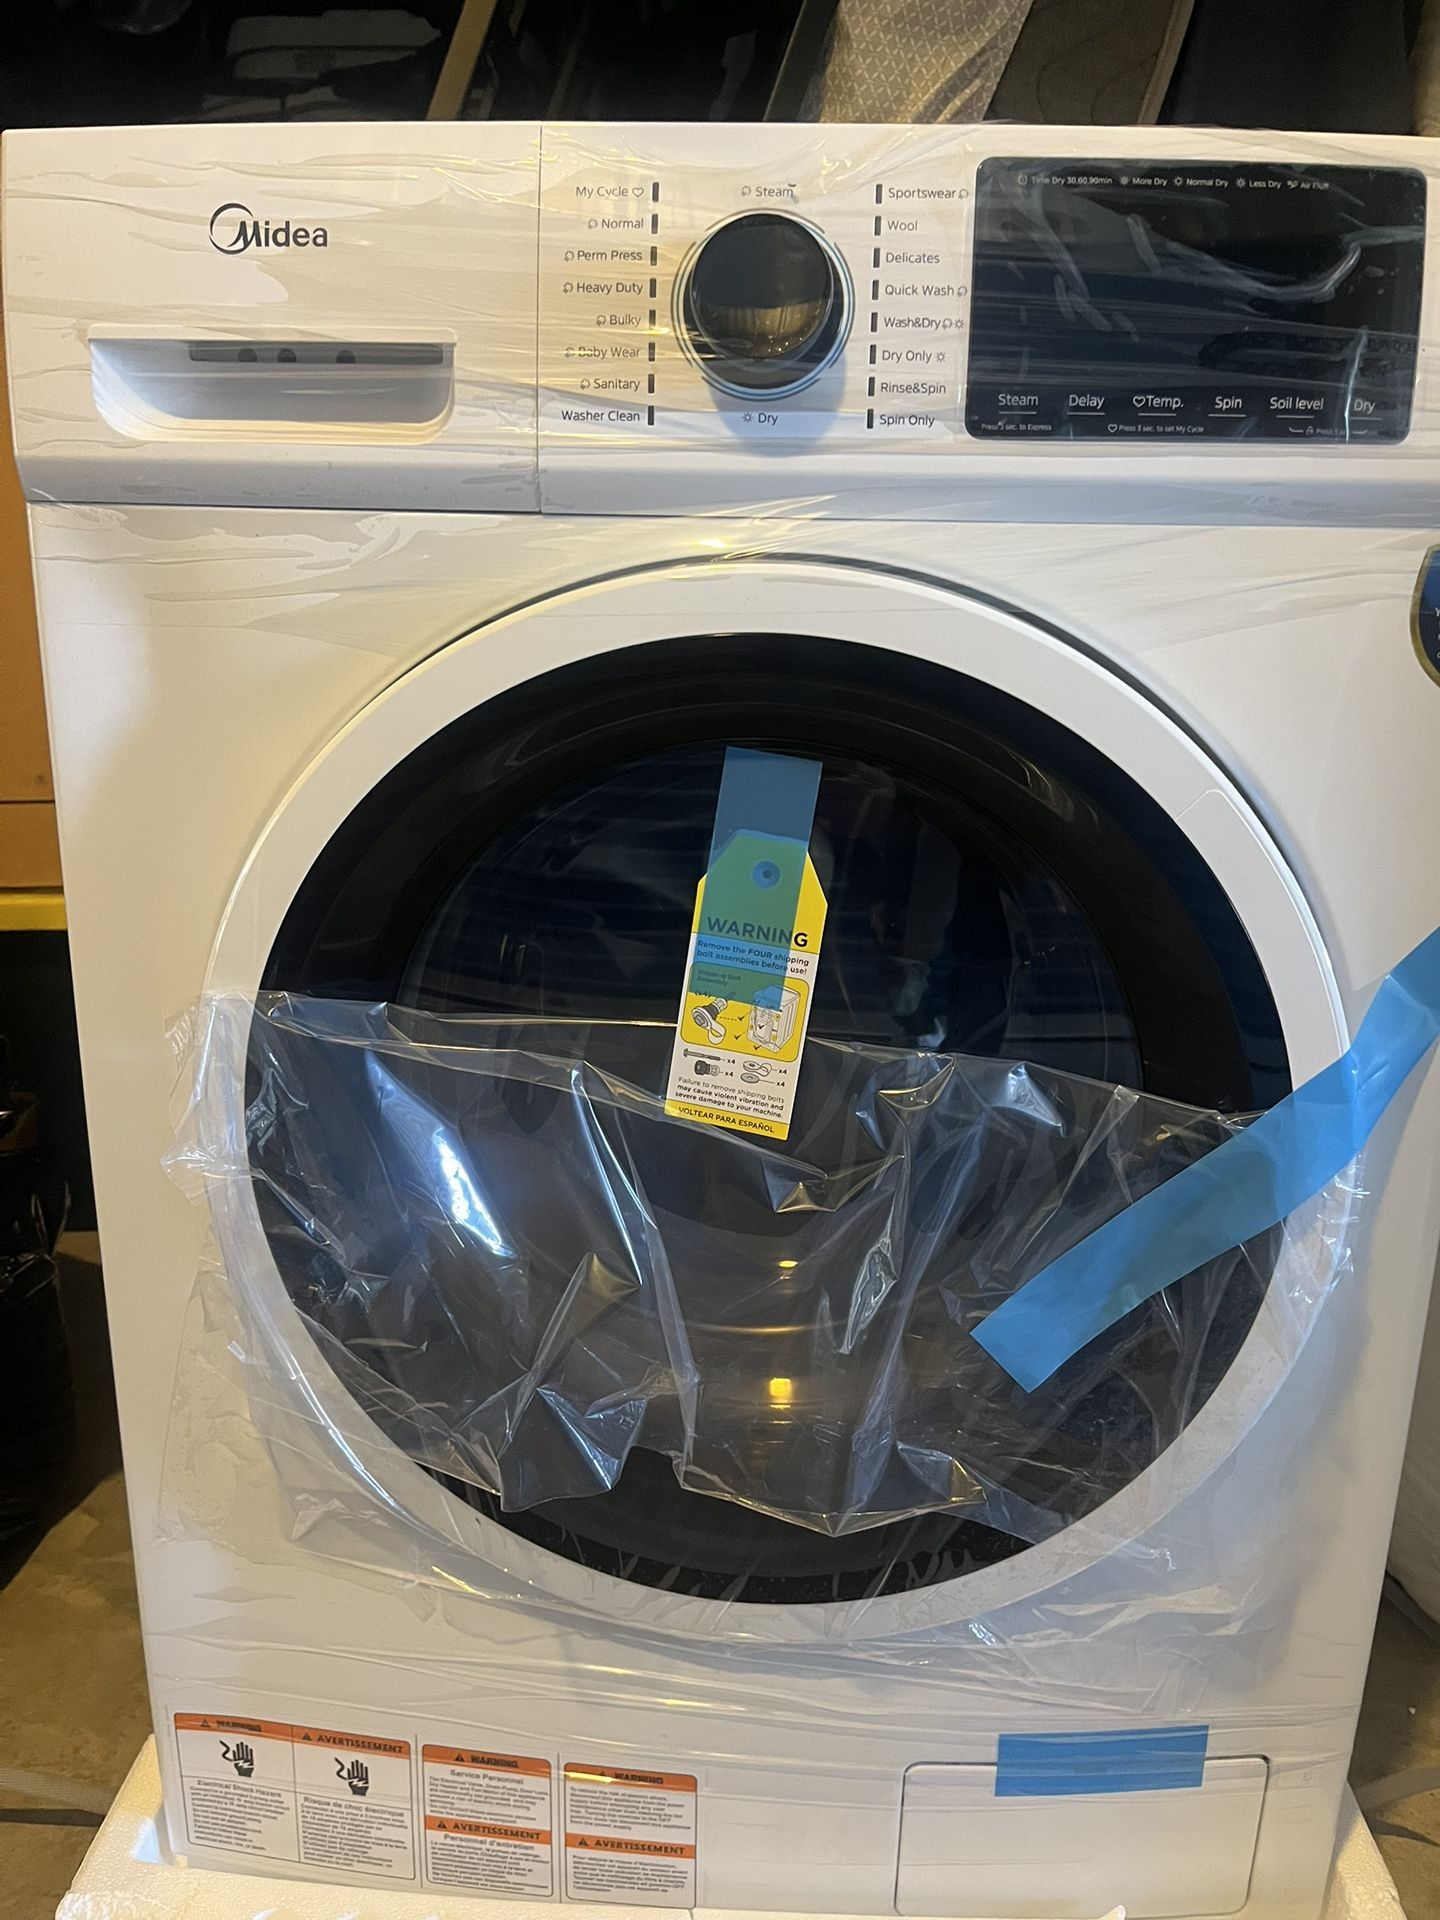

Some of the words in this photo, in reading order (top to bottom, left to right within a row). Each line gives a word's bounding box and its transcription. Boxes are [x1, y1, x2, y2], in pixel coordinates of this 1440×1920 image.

[1052, 177, 1065, 186] Dry
[1132, 177, 1152, 185] More
[1154, 178, 1167, 187] Dry
[1186, 178, 1214, 186] Normal
[1215, 179, 1228, 188] Dry
[1250, 179, 1266, 188] Less
[1268, 180, 1281, 189] Dry
[576, 186, 594, 199] My
[597, 186, 629, 198] Cycle
[754, 185, 794, 198] Steam
[888, 187, 956, 199] Sportswear
[208, 202, 328, 255] Midea
[601, 219, 644, 229] Normal
[887, 220, 918, 231] Wool
[577, 250, 607, 261] Perm
[611, 250, 643, 261] Press
[886, 252, 940, 264] Delicates
[576, 283, 613, 295] Heavy
[616, 283, 643, 295] Duty
[885, 284, 918, 296] Quick
[922, 285, 954, 296] Wash
[610, 315, 641, 327] Bulky
[884, 317, 940, 330] Wash&Dry
[578, 346, 607, 360] Baby
[611, 347, 640, 357] Wear
[882, 350, 902, 363] Dry
[906, 351, 932, 363] Only
[594, 379, 640, 392] Sanitary
[881, 383, 946, 395] Rinse&Spin
[998, 394, 1038, 406] Steam
[1068, 395, 1105, 409] Delay
[1146, 396, 1184, 409] Temp.
[1214, 397, 1243, 410] Spin
[1270, 397, 1292, 409] Soil
[1296, 398, 1324, 410] level
[1354, 400, 1376, 414] Dry
[561, 410, 604, 421] Washer
[608, 411, 640, 421] Clean
[757, 411, 779, 427] Dry
[880, 414, 905, 427] Spin
[909, 415, 935, 428] Only
[1027, 424, 1052, 432] Express
[1119, 424, 1136, 432] Press
[1176, 425, 1186, 434] My
[1187, 426, 1204, 434] Cycle
[707, 917, 808, 947] WARNING
[698, 940, 731, 951] Remove
[733, 946, 746, 954] the
[748, 949, 772, 959] FOUR
[774, 953, 809, 967] shipping
[697, 949, 713, 959] bolt
[716, 952, 759, 966] assemblies
[761, 960, 788, 971] before
[790, 967, 807, 975] use!
[679, 1076, 701, 1086] Failure
[711, 1084, 739, 1093] remove
[737, 1088, 766, 1100] shipping
[768, 1095, 784, 1103] bolts
[677, 1084, 691, 1092] may
[693, 1087, 712, 1096] cause
[714, 1090, 737, 1101] violent
[739, 1097, 769, 1108] vibration
[770, 1103, 784, 1111] and
[675, 1092, 696, 1100] severe
[698, 1096, 726, 1106] damage
[736, 1104, 751, 1112] your
[753, 1107, 782, 1118] machine.
[679, 1106, 714, 1119] VOLTEAR
[716, 1114, 736, 1125] PARA
[739, 1120, 774, 1133] ESPAÑOL
[318, 1735, 403, 1753] AVERTISSEMENT
[453, 1822, 540, 1840] AVERTISSEMENT
[595, 1839, 684, 1854] AVERTISSEMENT
